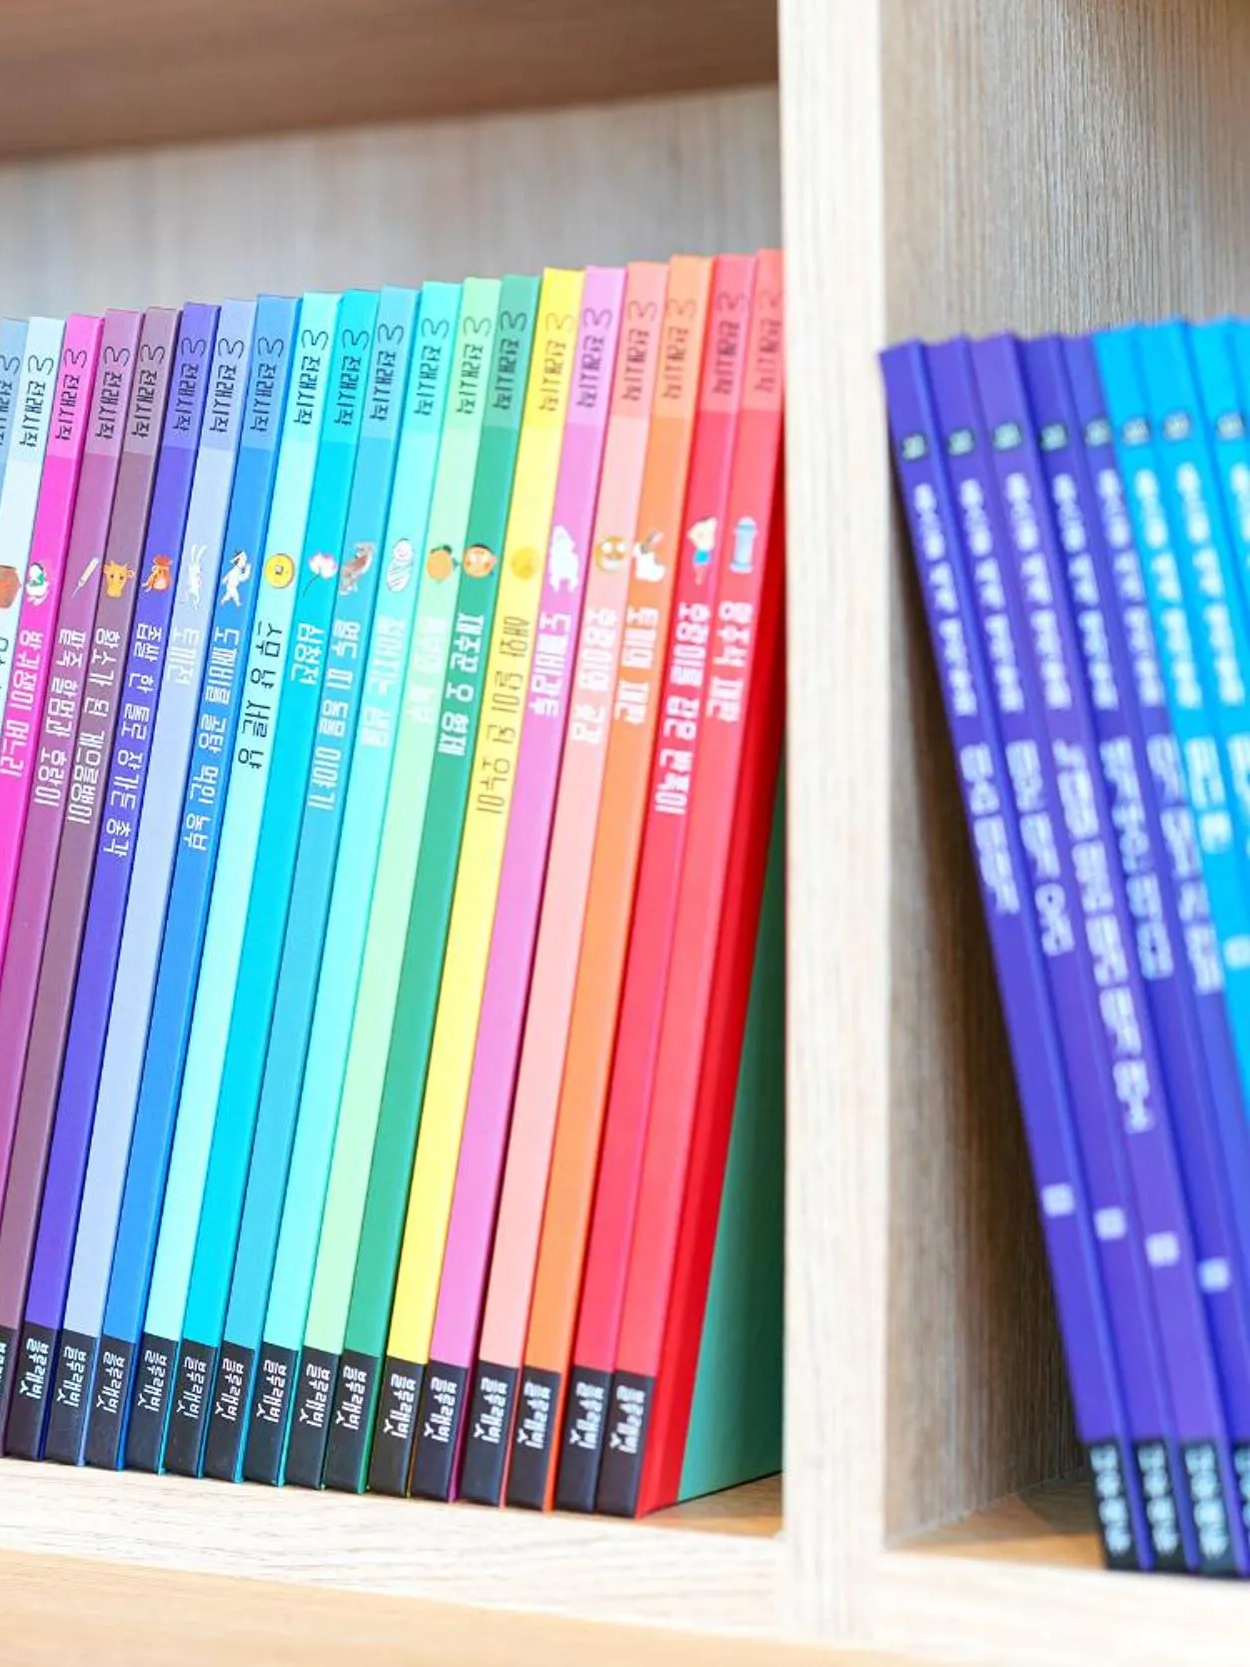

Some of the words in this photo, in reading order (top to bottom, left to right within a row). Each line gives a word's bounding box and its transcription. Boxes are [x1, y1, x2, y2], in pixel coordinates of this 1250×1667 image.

[293, 355, 321, 425] 전래시작
[334, 356, 361, 426] 전래시작
[370, 351, 396, 421] 전래시작
[414, 346, 442, 416] 전래시작
[456, 344, 484, 413] 전래시작
[493, 338, 520, 409] 전래시작
[539, 341, 566, 411] 전래시작
[577, 337, 606, 408] 전래시작
[623, 329, 649, 401] 전래시작
[662, 327, 689, 399] 전래시작
[19, 380, 46, 448] 전래시작
[55, 374, 80, 441] 전래시작
[95, 372, 123, 440] 전래시작
[131, 369, 158, 438] 전래시작
[172, 362, 200, 432] 전래시작
[209, 364, 237, 433] 전래시작
[250, 362, 277, 432] 전래시작
[56, 628, 86, 669] 팥죽
[88, 628, 120, 687] 황소가
[134, 623, 162, 662] 좁쌀
[167, 626, 199, 686] 토끼전
[205, 626, 239, 705] 도깨비를
[256, 620, 282, 658] 스무
[290, 622, 324, 685] 심청전
[333, 619, 360, 659] 열두
[450, 612, 484, 673] 재주꾼
[499, 616, 530, 658] 해와
[528, 612, 571, 717] 도깨비감투
[580, 608, 617, 692] 호랑이와
[621, 606, 659, 669] 토끼의
[669, 602, 711, 688] 호랑이를
[9, 630, 43, 711] 방귀쟁이
[130, 672, 154, 694] 한
[250, 668, 276, 689] 냥
[327, 668, 353, 690] 띠
[446, 682, 474, 703] 오
[491, 671, 523, 714] 달이
[614, 679, 650, 725] 재판
[45, 677, 77, 737] 할멈과
[85, 697, 107, 717] 된
[120, 701, 150, 741] 톨로
[198, 713, 226, 754] 골탕
[242, 700, 270, 738] 서른
[318, 699, 348, 737] 동물
[438, 711, 469, 756] 형제
[486, 725, 516, 745] 된
[570, 703, 605, 744] 곶감
[663, 696, 700, 739] 잡은
[0, 719, 28, 777] 며느리
[33, 747, 67, 807] 호랑이
[67, 731, 104, 824] 게으름뱅이
[111, 749, 142, 810] 장가든
[238, 748, 264, 770] 냥
[308, 746, 342, 811] 이야기
[190, 765, 218, 804] 먹인
[475, 756, 510, 814] 오누이
[655, 749, 691, 815] 반쪽이
[103, 818, 131, 858] 총각
[183, 813, 210, 852] 농부
[19, 1337, 49, 1400] 블루래빗
[56, 1344, 87, 1408] 블루래빗
[96, 1351, 126, 1413] 블루래빗
[137, 1349, 167, 1411] 블루래빗
[177, 1356, 207, 1418] 블루래빗
[215, 1358, 244, 1421] 블루래빗
[256, 1359, 287, 1423] 블루래빗
[299, 1363, 330, 1428] 블루래빗
[335, 1365, 367, 1429] 블루래빗
[383, 1373, 416, 1439] 블루래빗
[423, 1376, 457, 1443] 블루래빗
[473, 1377, 508, 1444] 블루래빗
[516, 1381, 550, 1449] 블루래빗
